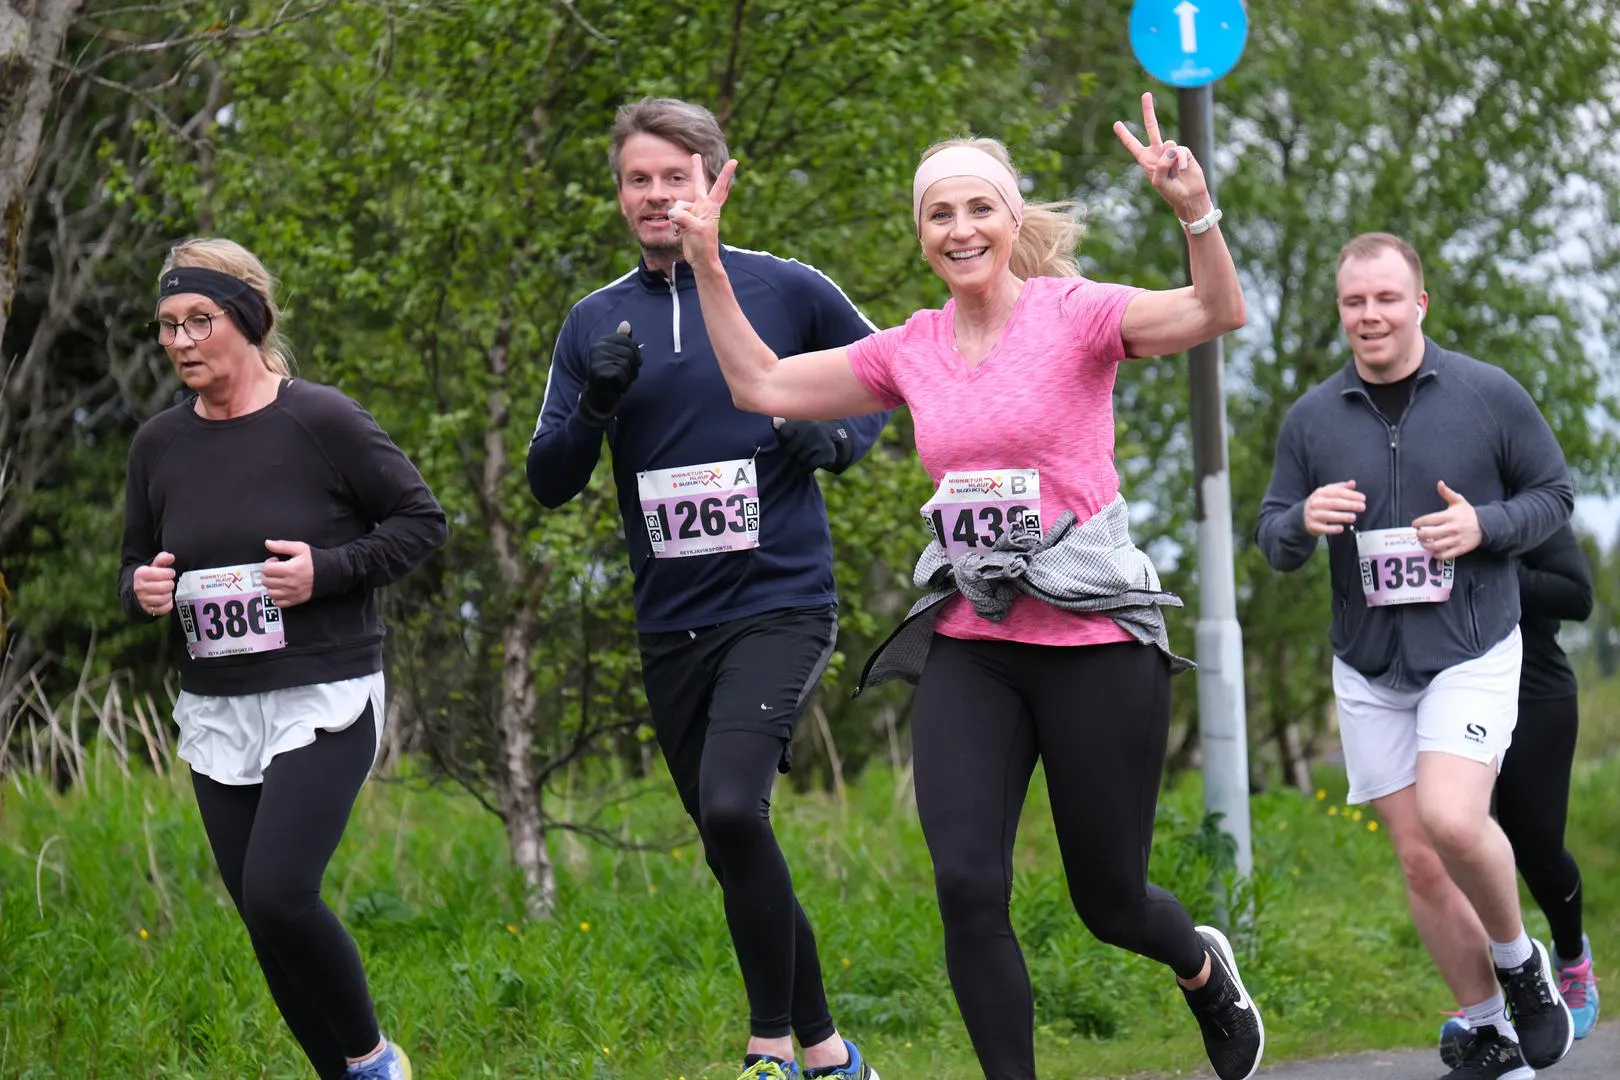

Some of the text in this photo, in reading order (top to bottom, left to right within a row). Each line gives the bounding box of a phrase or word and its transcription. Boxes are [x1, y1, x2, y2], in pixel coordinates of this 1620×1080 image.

[734, 467, 750, 486] A
[1010, 476, 1027, 495] B
[656, 494, 748, 541] 1263
[1370, 555, 1443, 591] 1359
[189, 597, 266, 641] 1386
